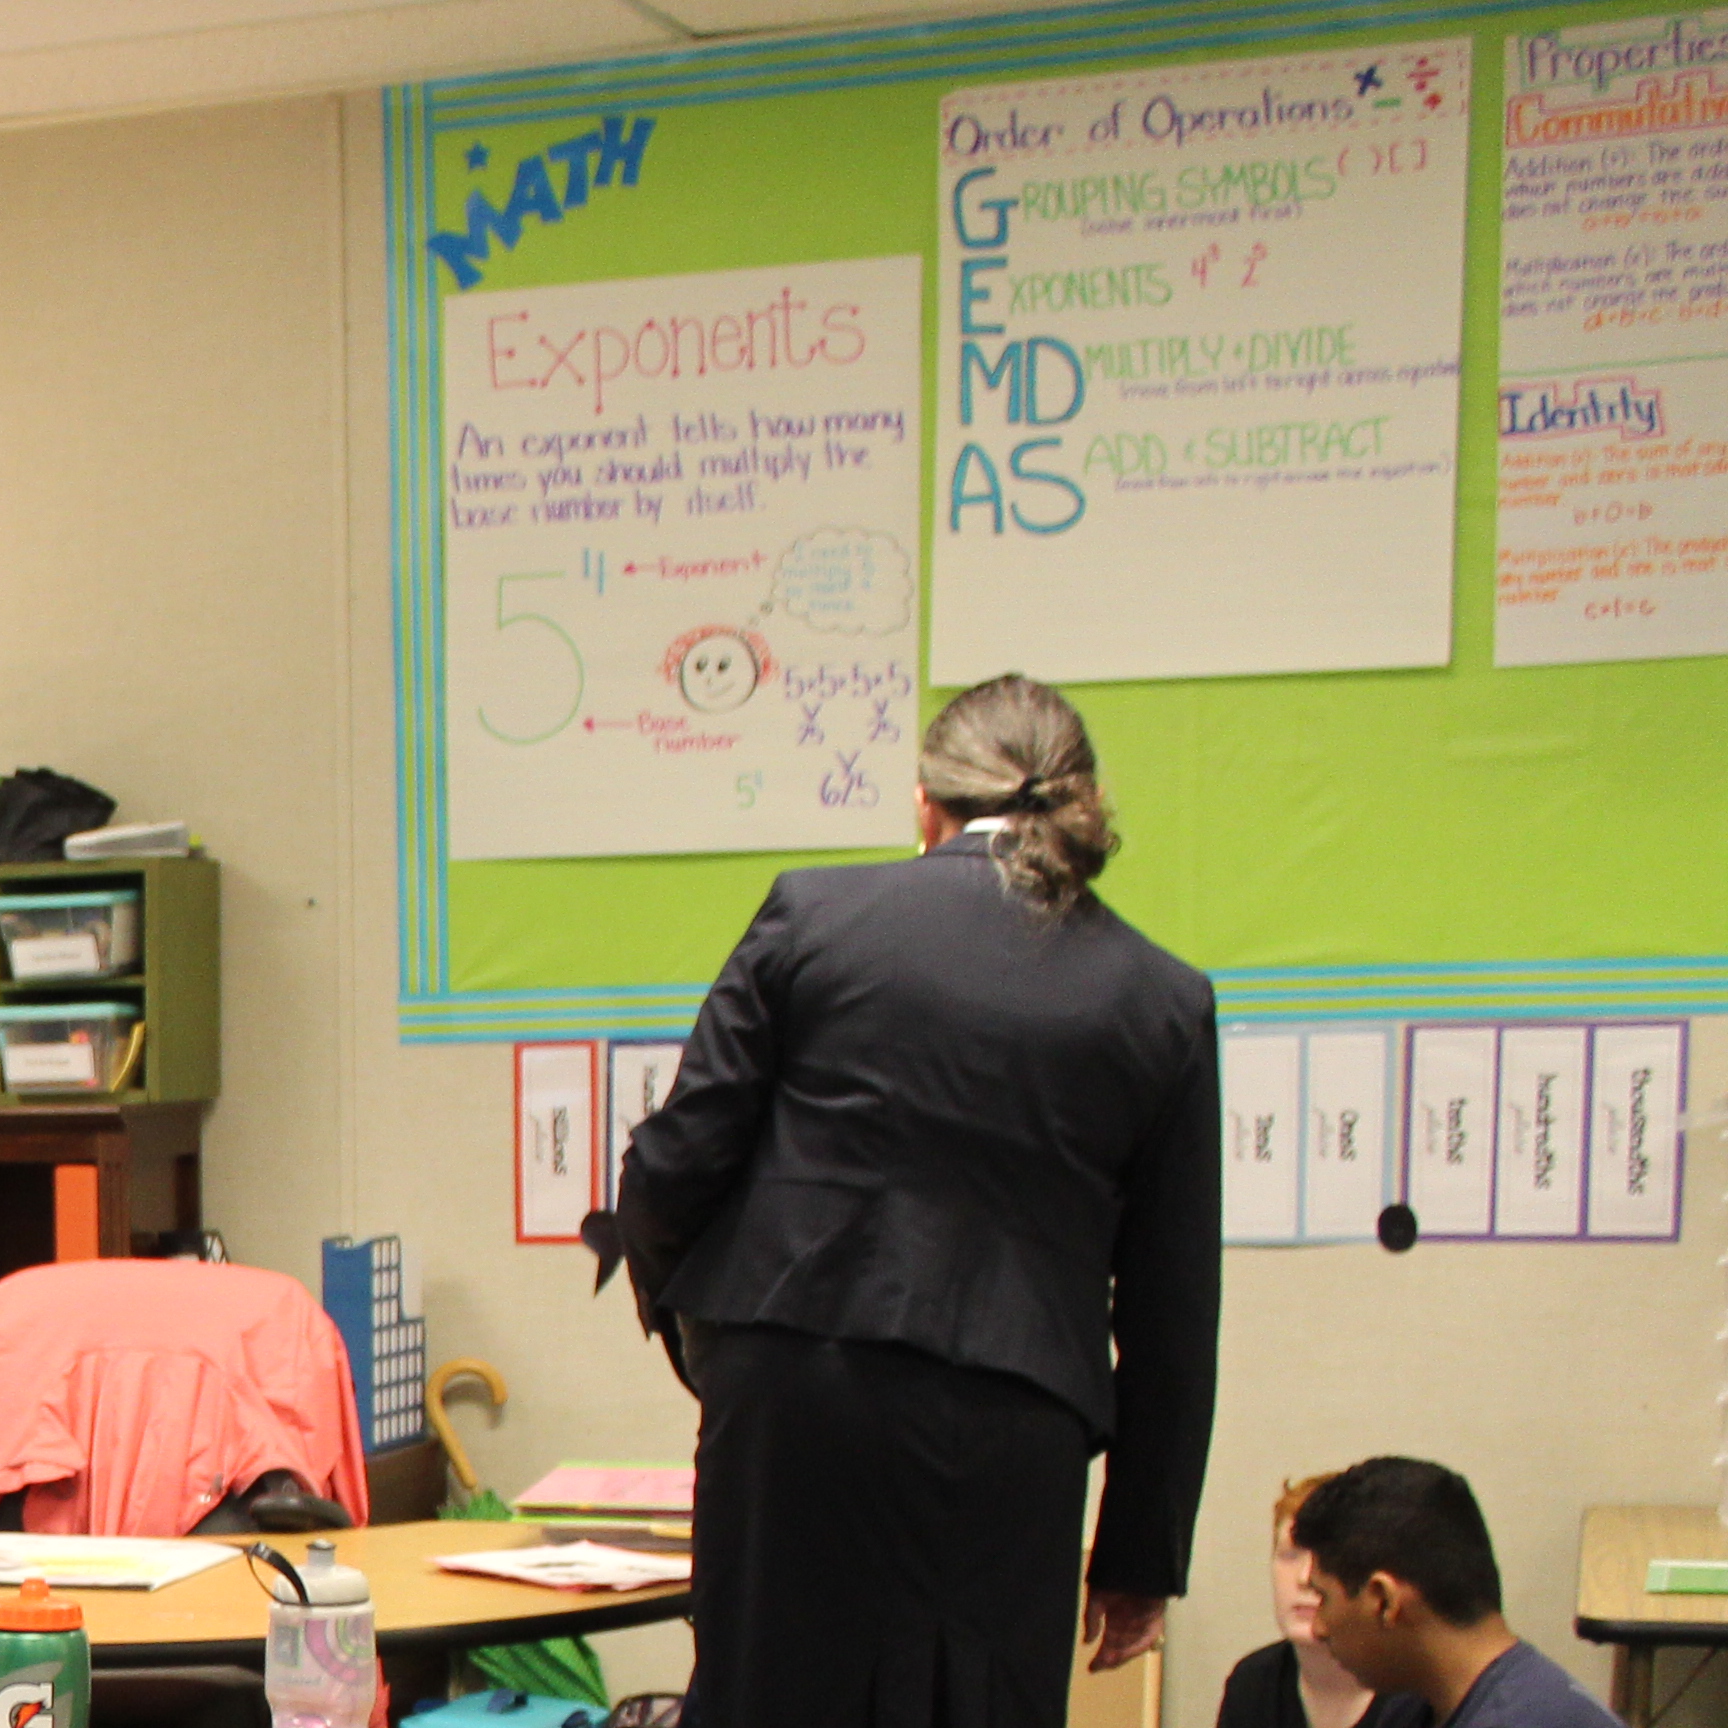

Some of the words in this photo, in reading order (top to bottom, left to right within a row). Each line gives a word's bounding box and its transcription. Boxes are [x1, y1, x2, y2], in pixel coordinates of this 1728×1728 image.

[948, 110, 1065, 156] Order
[1090, 102, 1121, 143] of
[1143, 88, 1356, 148] Operations
[426, 116, 656, 292] MATH
[489, 286, 866, 416] Exponents
[458, 421, 504, 460] An
[521, 413, 648, 463] exponent
[749, 408, 815, 441] how
[822, 409, 906, 443] many
[1499, 386, 1658, 438] Identity
[1204, 415, 1394, 469] SUBTRACT
[537, 463, 584, 499] you
[700, 445, 813, 483] multiply
